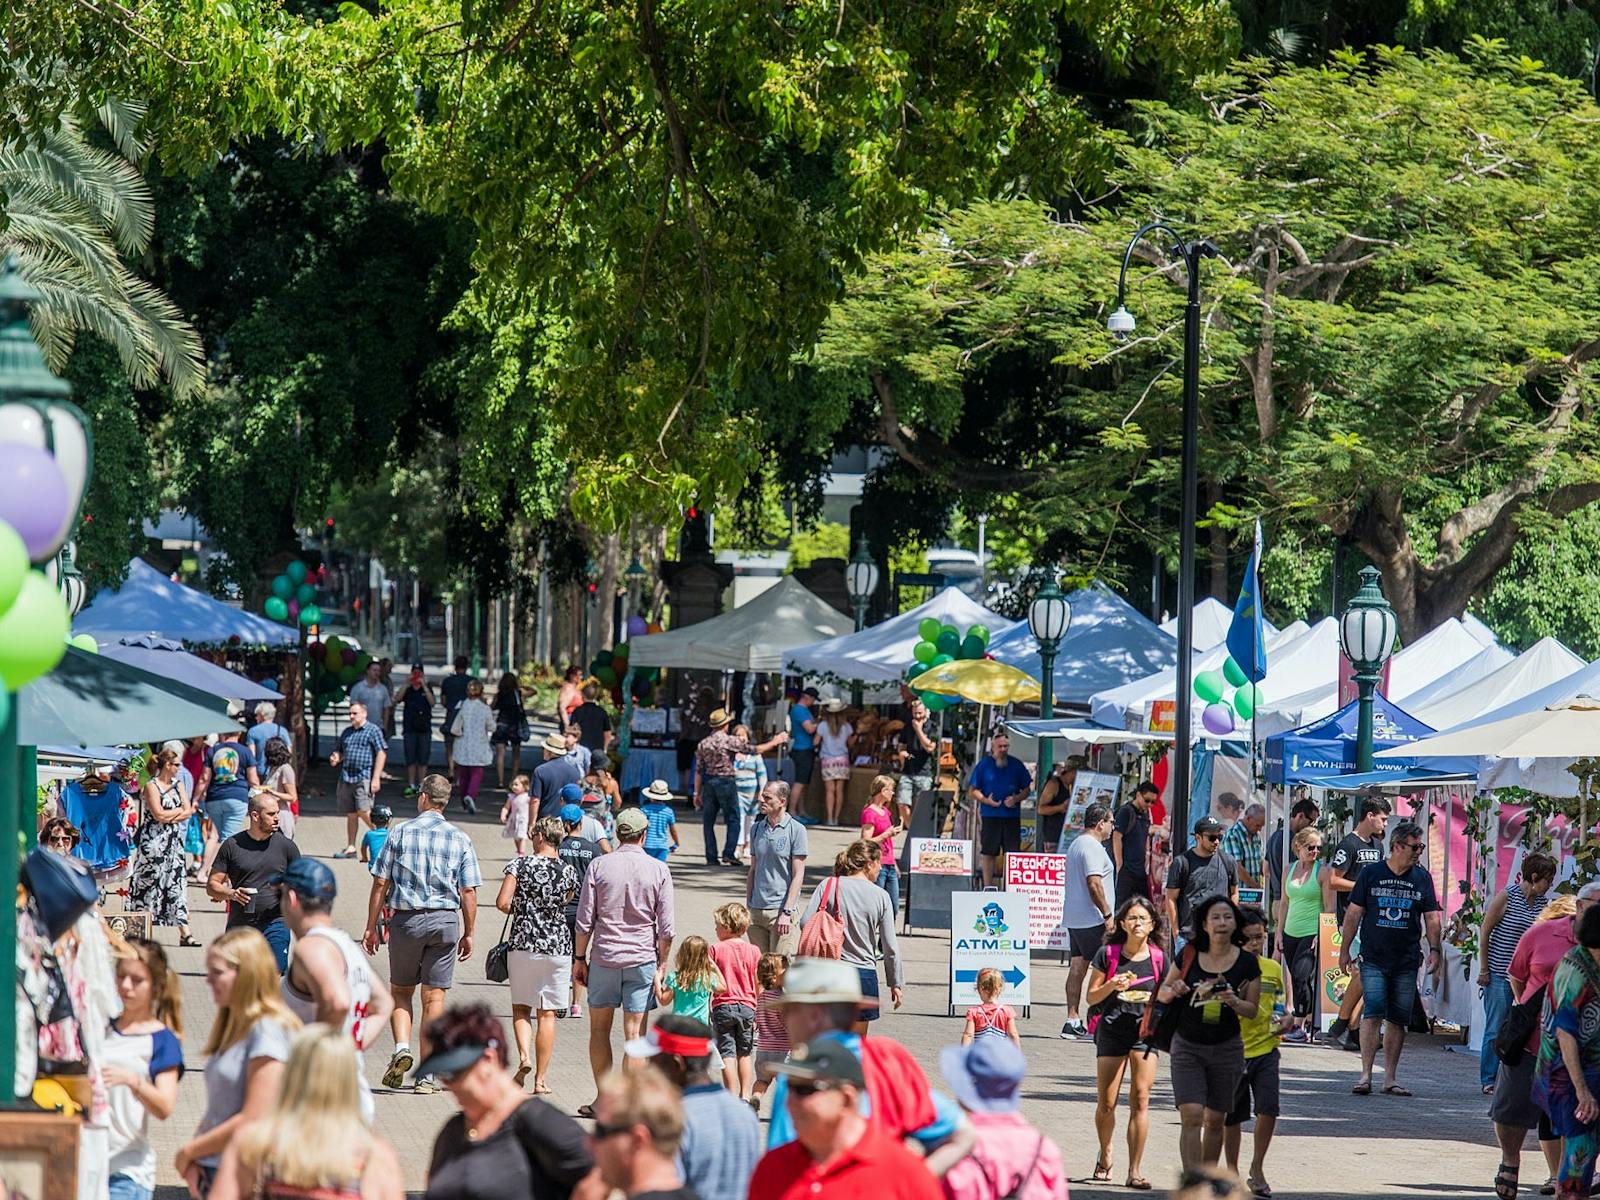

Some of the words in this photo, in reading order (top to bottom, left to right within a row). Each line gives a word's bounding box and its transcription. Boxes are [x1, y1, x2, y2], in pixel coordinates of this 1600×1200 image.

[1303, 760, 1328, 768] ATM
[559, 848, 593, 858] FINISHER
[1009, 870, 1066, 884] ROLLS
[956, 939, 1026, 949] ATM2U
